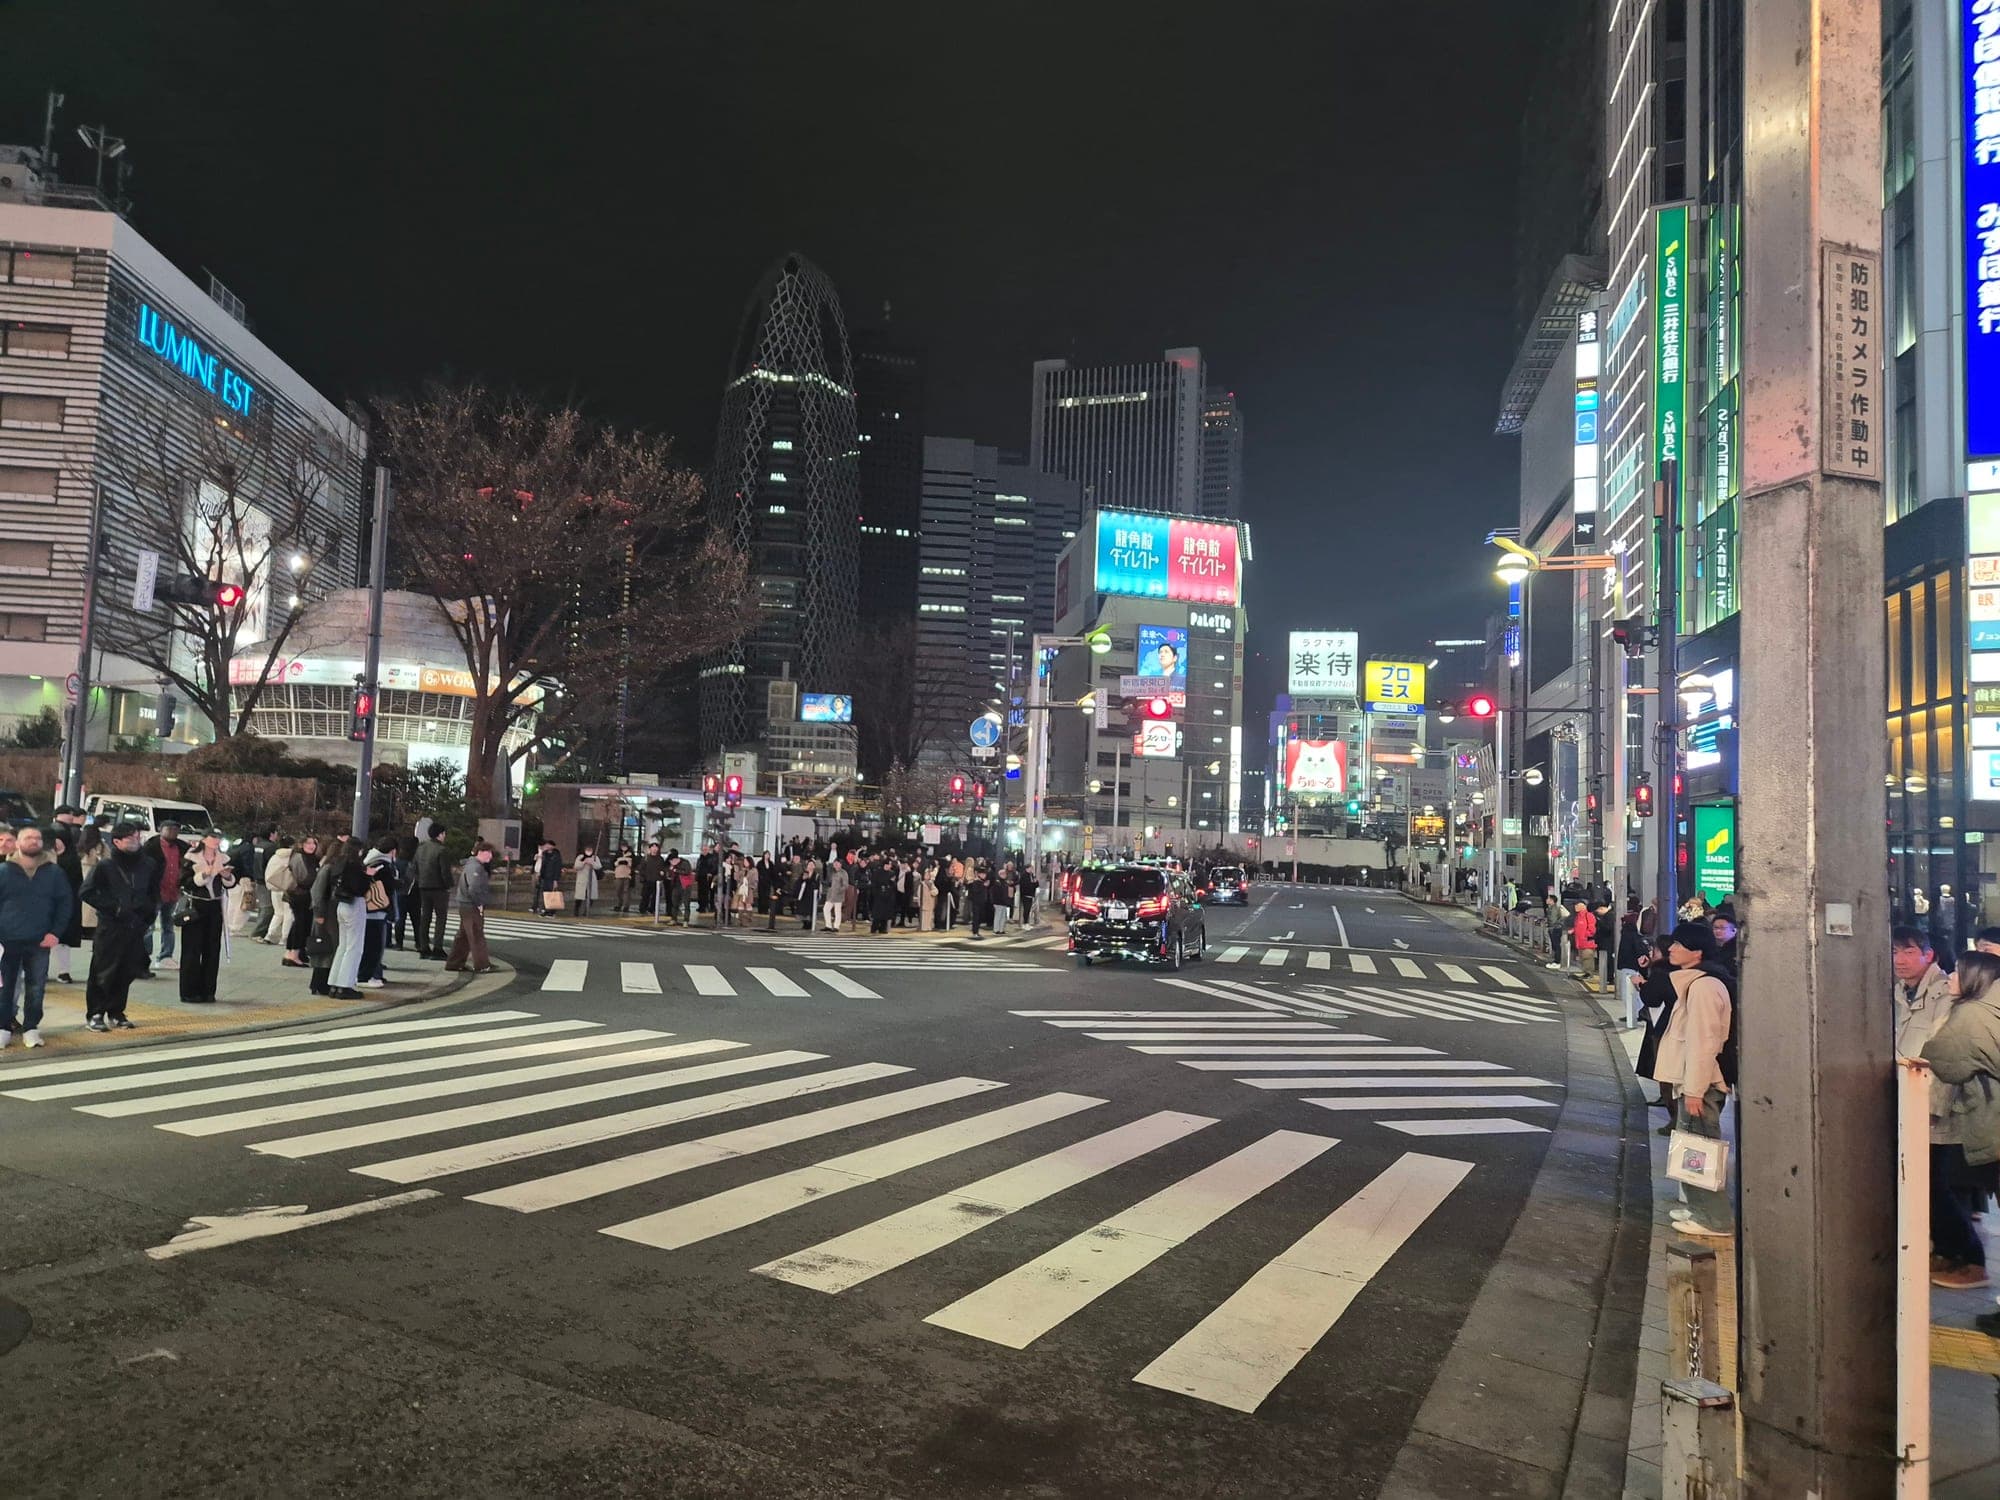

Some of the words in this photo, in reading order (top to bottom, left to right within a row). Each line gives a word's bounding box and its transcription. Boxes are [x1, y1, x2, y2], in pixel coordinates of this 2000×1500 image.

[1664, 257, 1679, 298] SMBC
[138, 303, 218, 394] LUMINE
[223, 367, 254, 416] EST
[1662, 303, 1679, 384] 三井住友銀行
[1850, 262, 1869, 468] 防犯カメラ作動中
[1662, 410, 1676, 456] SMBC
[1295, 651, 1353, 677] 楽待
[1302, 639, 1345, 648] ラクマチ
[1705, 855, 1731, 864] SMBC
